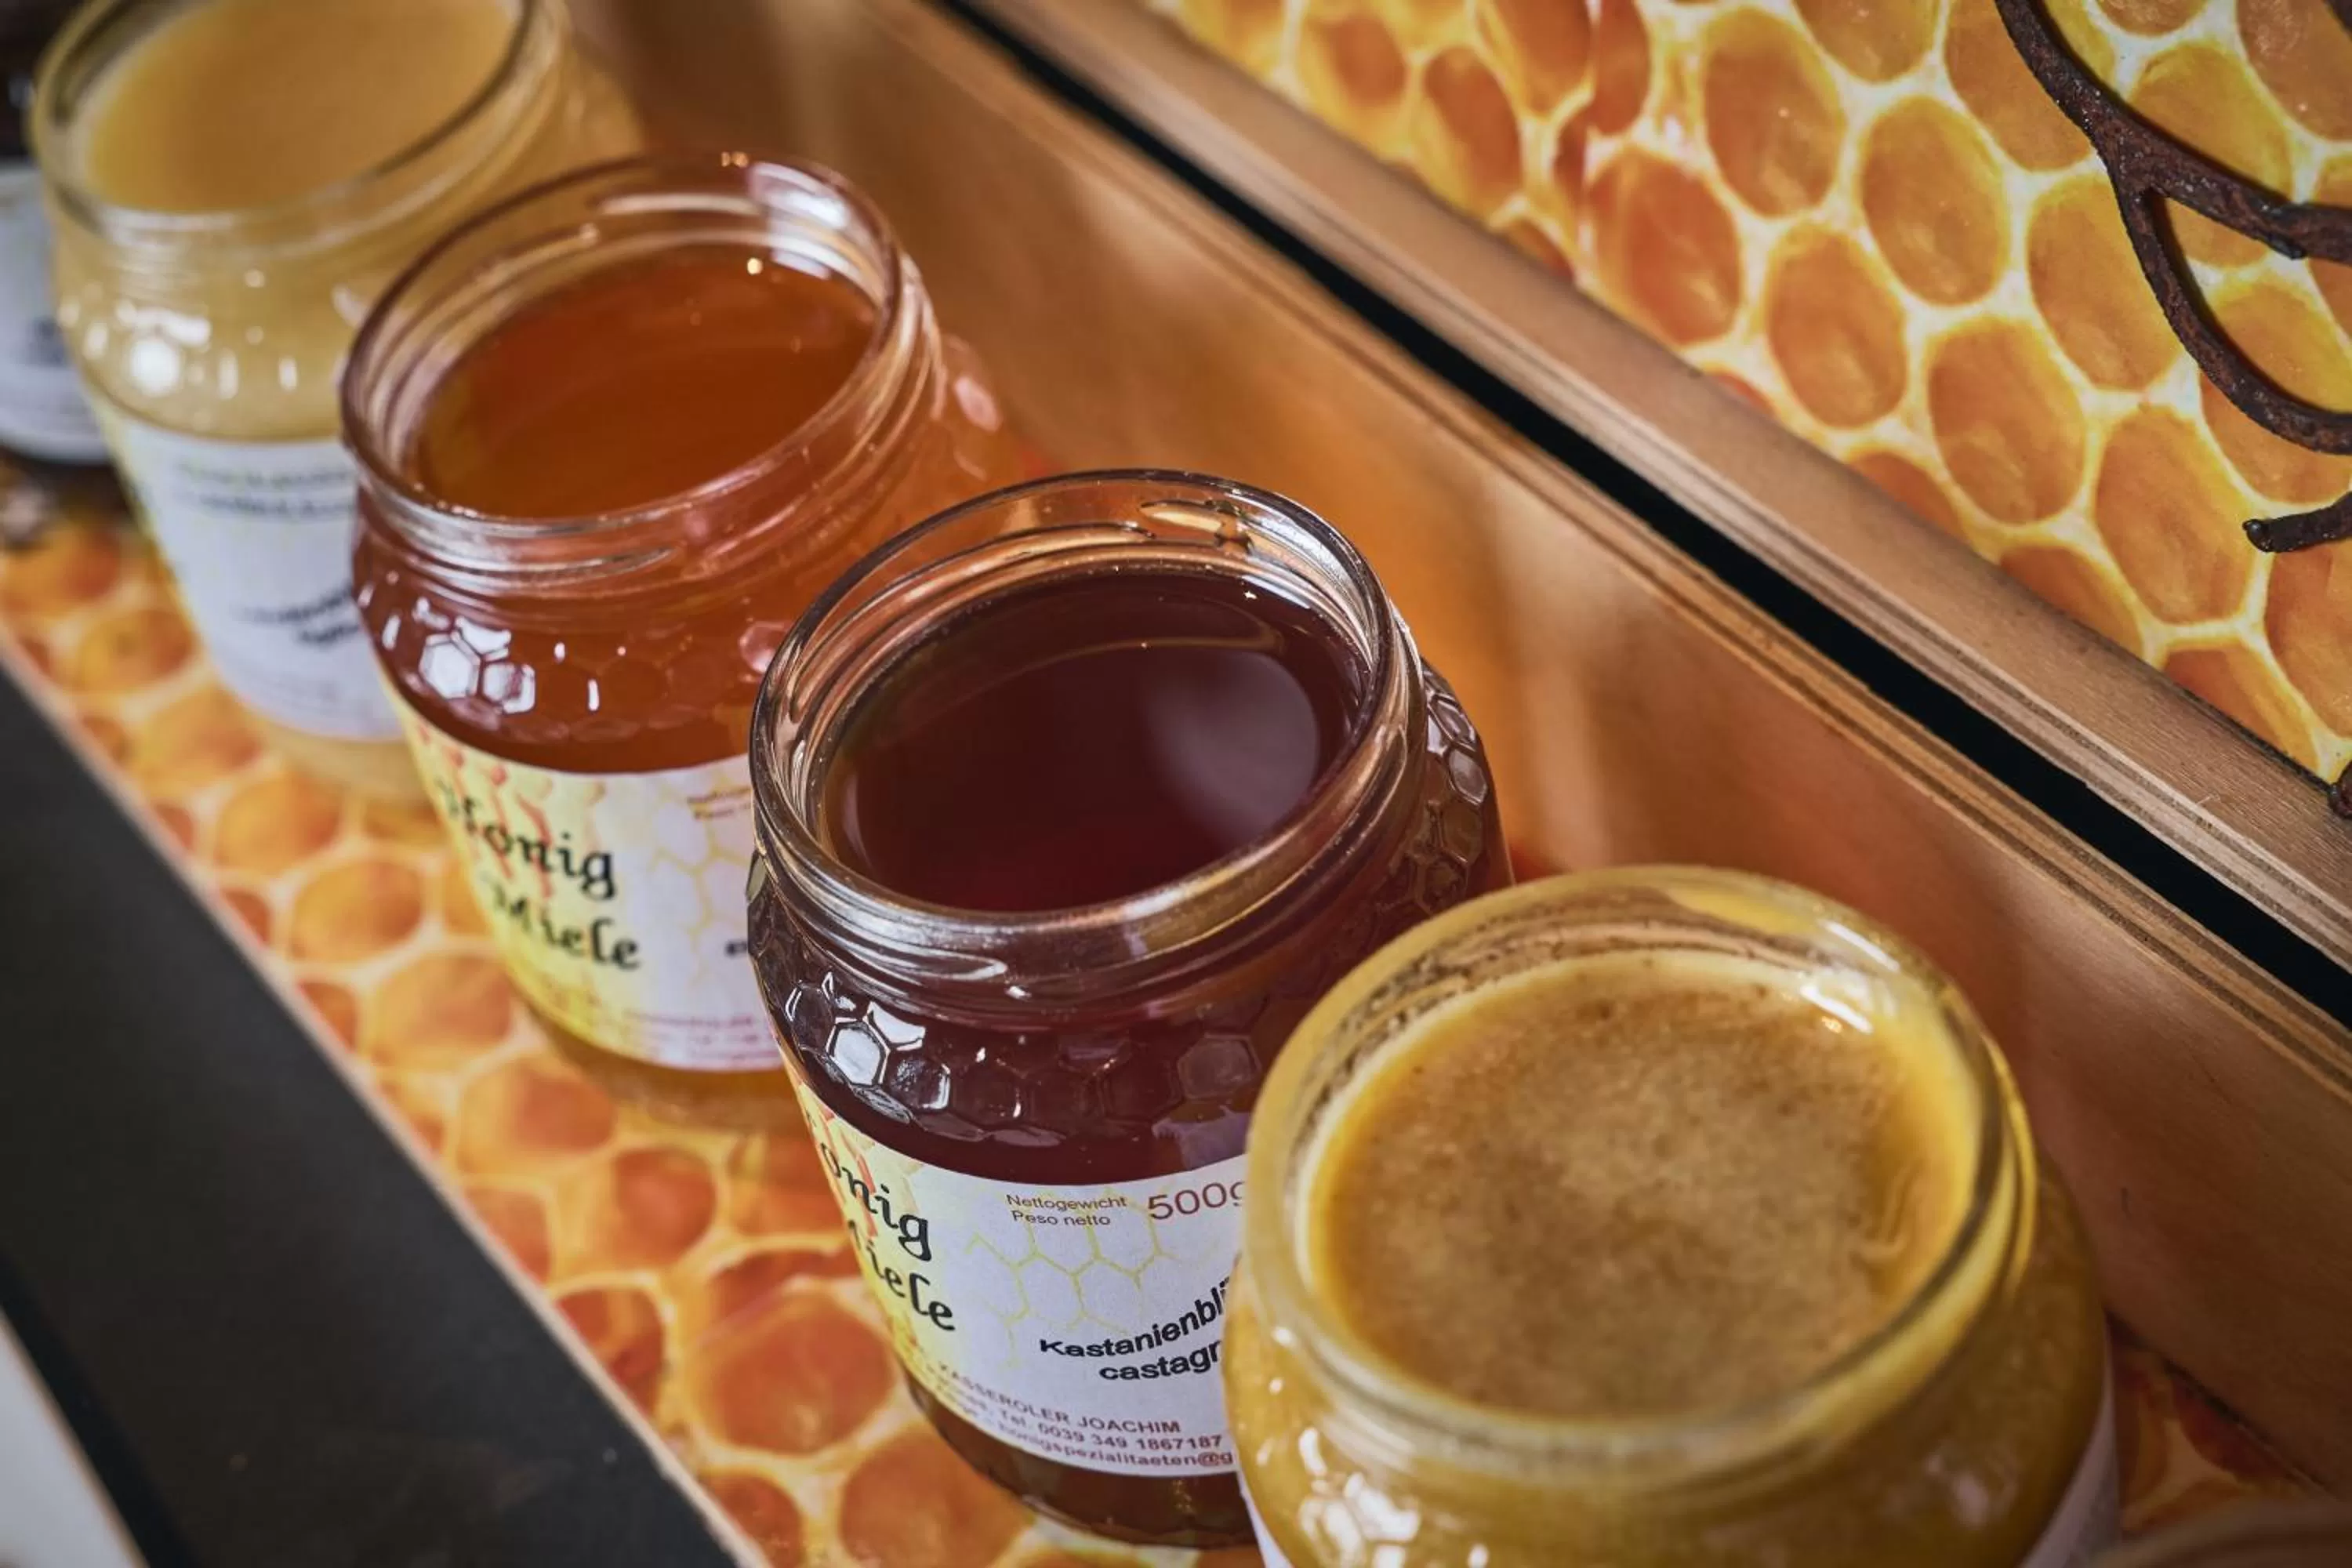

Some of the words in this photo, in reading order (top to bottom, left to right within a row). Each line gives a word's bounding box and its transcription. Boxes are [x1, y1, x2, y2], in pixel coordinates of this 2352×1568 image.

[811, 1129, 933, 1262] onig
[1005, 1192, 1127, 1212] Nettogewicht
[1011, 1210, 1058, 1226] Peso
[1064, 1213, 1112, 1226] netto
[1077, 1416, 1181, 1434] JOACHIM
[1037, 1421, 1085, 1443] 0039
[1091, 1432, 1128, 1449] 349
[1135, 1435, 1223, 1451] 1867187
